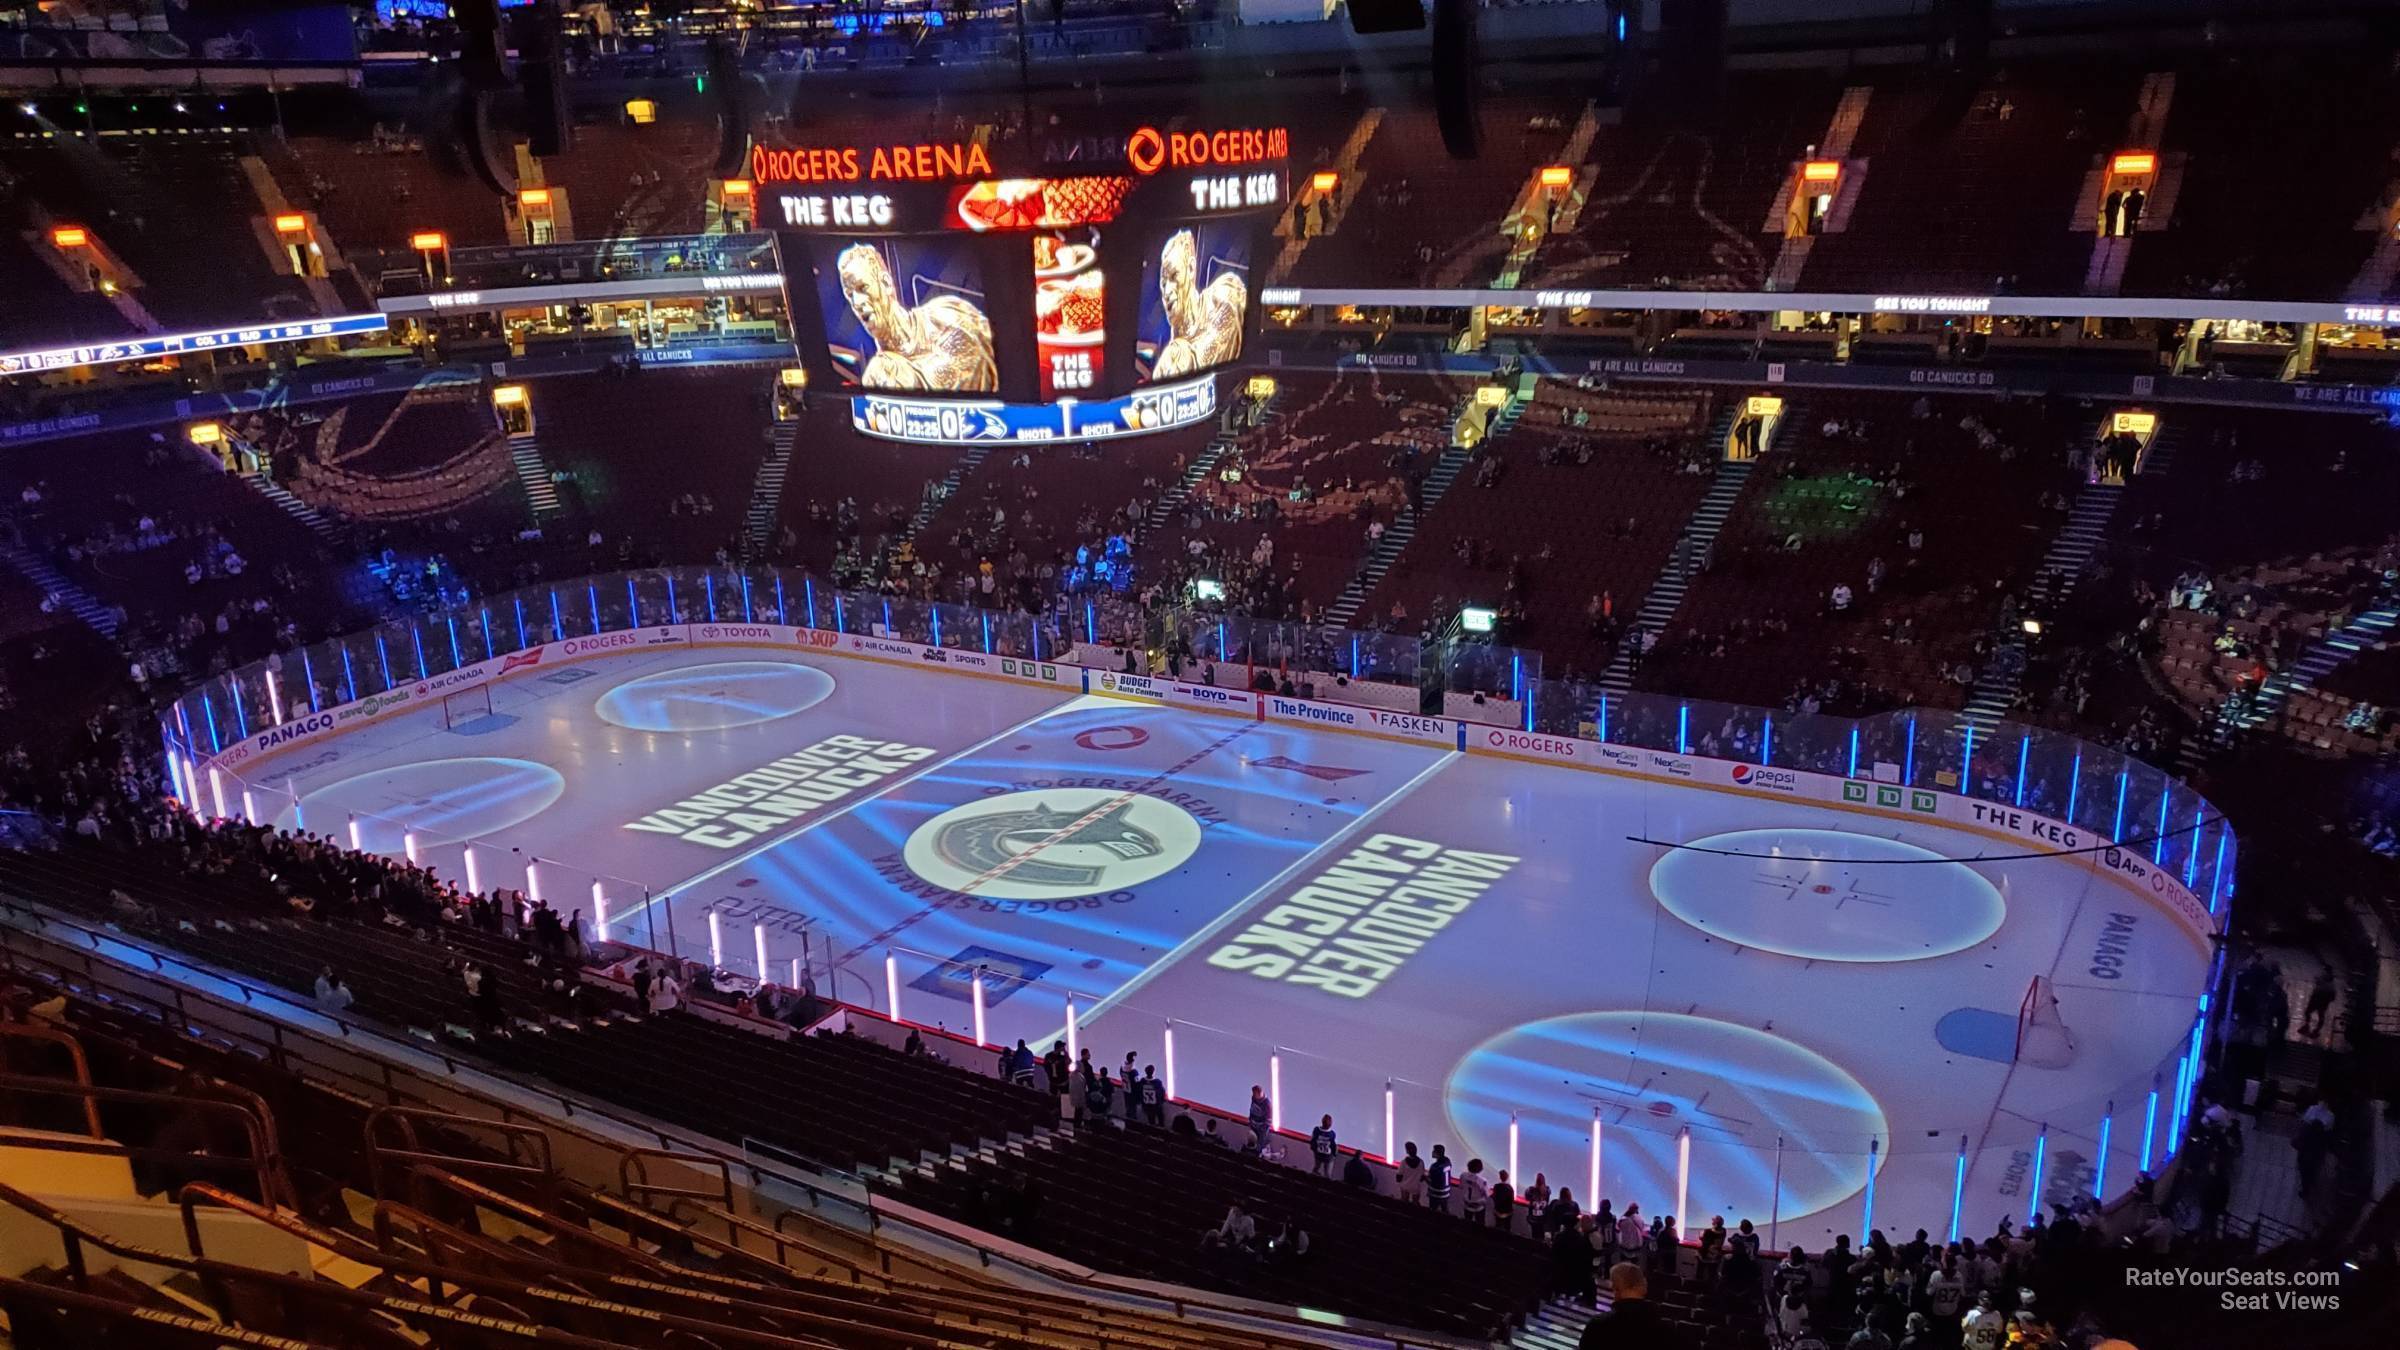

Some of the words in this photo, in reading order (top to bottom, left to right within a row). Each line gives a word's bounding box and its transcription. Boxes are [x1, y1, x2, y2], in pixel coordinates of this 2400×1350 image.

[1170, 129, 1263, 166] ROGERS
[1267, 128, 1288, 159] ARE
[768, 149, 859, 180] ROGERS
[870, 143, 992, 179] ARENA
[1191, 177, 1240, 210] THE
[1245, 173, 1277, 205] KEG
[780, 196, 827, 225] THE
[832, 195, 892, 226] KEG
[1536, 292, 1564, 306] THE
[1875, 297, 1900, 311] SEE
[1900, 298, 1929, 311] YOU
[1929, 298, 1991, 313] TONIGHT
[2345, 307, 2385, 321] THE
[642, 352, 656, 362] ALL
[657, 350, 693, 361] CANUCKS
[1050, 353, 1091, 371] THE
[1356, 354, 1367, 364] GO
[1368, 354, 1404, 366] CANUCKS
[1406, 355, 1418, 366] GO
[1589, 359, 1602, 371] WE
[1604, 360, 1621, 372] ARE
[1624, 361, 1640, 373] ALL
[1642, 362, 1685, 375] CANUCKS
[1052, 370, 1093, 390] KEG
[1910, 370, 1925, 383] GO
[1927, 371, 1977, 385] CANUCKS
[1978, 374, 1995, 386] GO
[2295, 387, 2313, 400] WE
[2316, 388, 2340, 402] ARE
[2345, 389, 2368, 403] ALL
[1160, 393, 1174, 424] 0
[889, 406, 904, 435] 0
[907, 420, 939, 438] 23:25
[940, 409, 958, 440] 0
[1081, 423, 1116, 437] SHOTS
[1017, 427, 1053, 440] SHOTS
[580, 633, 637, 651] ROGERS
[722, 627, 772, 639] TOYOTA
[809, 629, 839, 648] SKIP
[864, 641, 878, 651] AIR
[879, 644, 913, 656] CANADA
[954, 654, 987, 667] SPORTS
[430, 681, 445, 691] AIR
[446, 668, 484, 686] CANADA
[1119, 675, 1152, 689] BUDGET
[1118, 685, 1134, 693] Auto
[1135, 688, 1164, 699] Centres
[1192, 688, 1227, 701] BOYD
[1273, 699, 1297, 716] The
[1298, 703, 1355, 725] Province
[259, 714, 334, 750] PANAGO
[1380, 713, 1444, 735] FASKEN
[1508, 734, 1575, 756] ROGERS
[1602, 748, 1639, 762] NexGen
[1654, 756, 1692, 770] NexGen
[622, 734, 888, 836] VANCOUVER
[1755, 770, 1795, 785] pepsi
[680, 743, 938, 849] CANUCKS
[1846, 784, 1866, 799] TD
[1880, 789, 1900, 804] TD
[1009, 777, 1142, 792] ROGERS
[1153, 787, 1229, 828] ARENA
[1914, 794, 1935, 810] TD
[1972, 803, 2022, 831] THE
[2032, 821, 2078, 848] KEG
[954, 895, 1105, 913] ROGERS
[1207, 833, 1444, 979] CANUCKS
[1286, 849, 1522, 998] VANCOUVER
[2089, 912, 2139, 980] PANAGO
